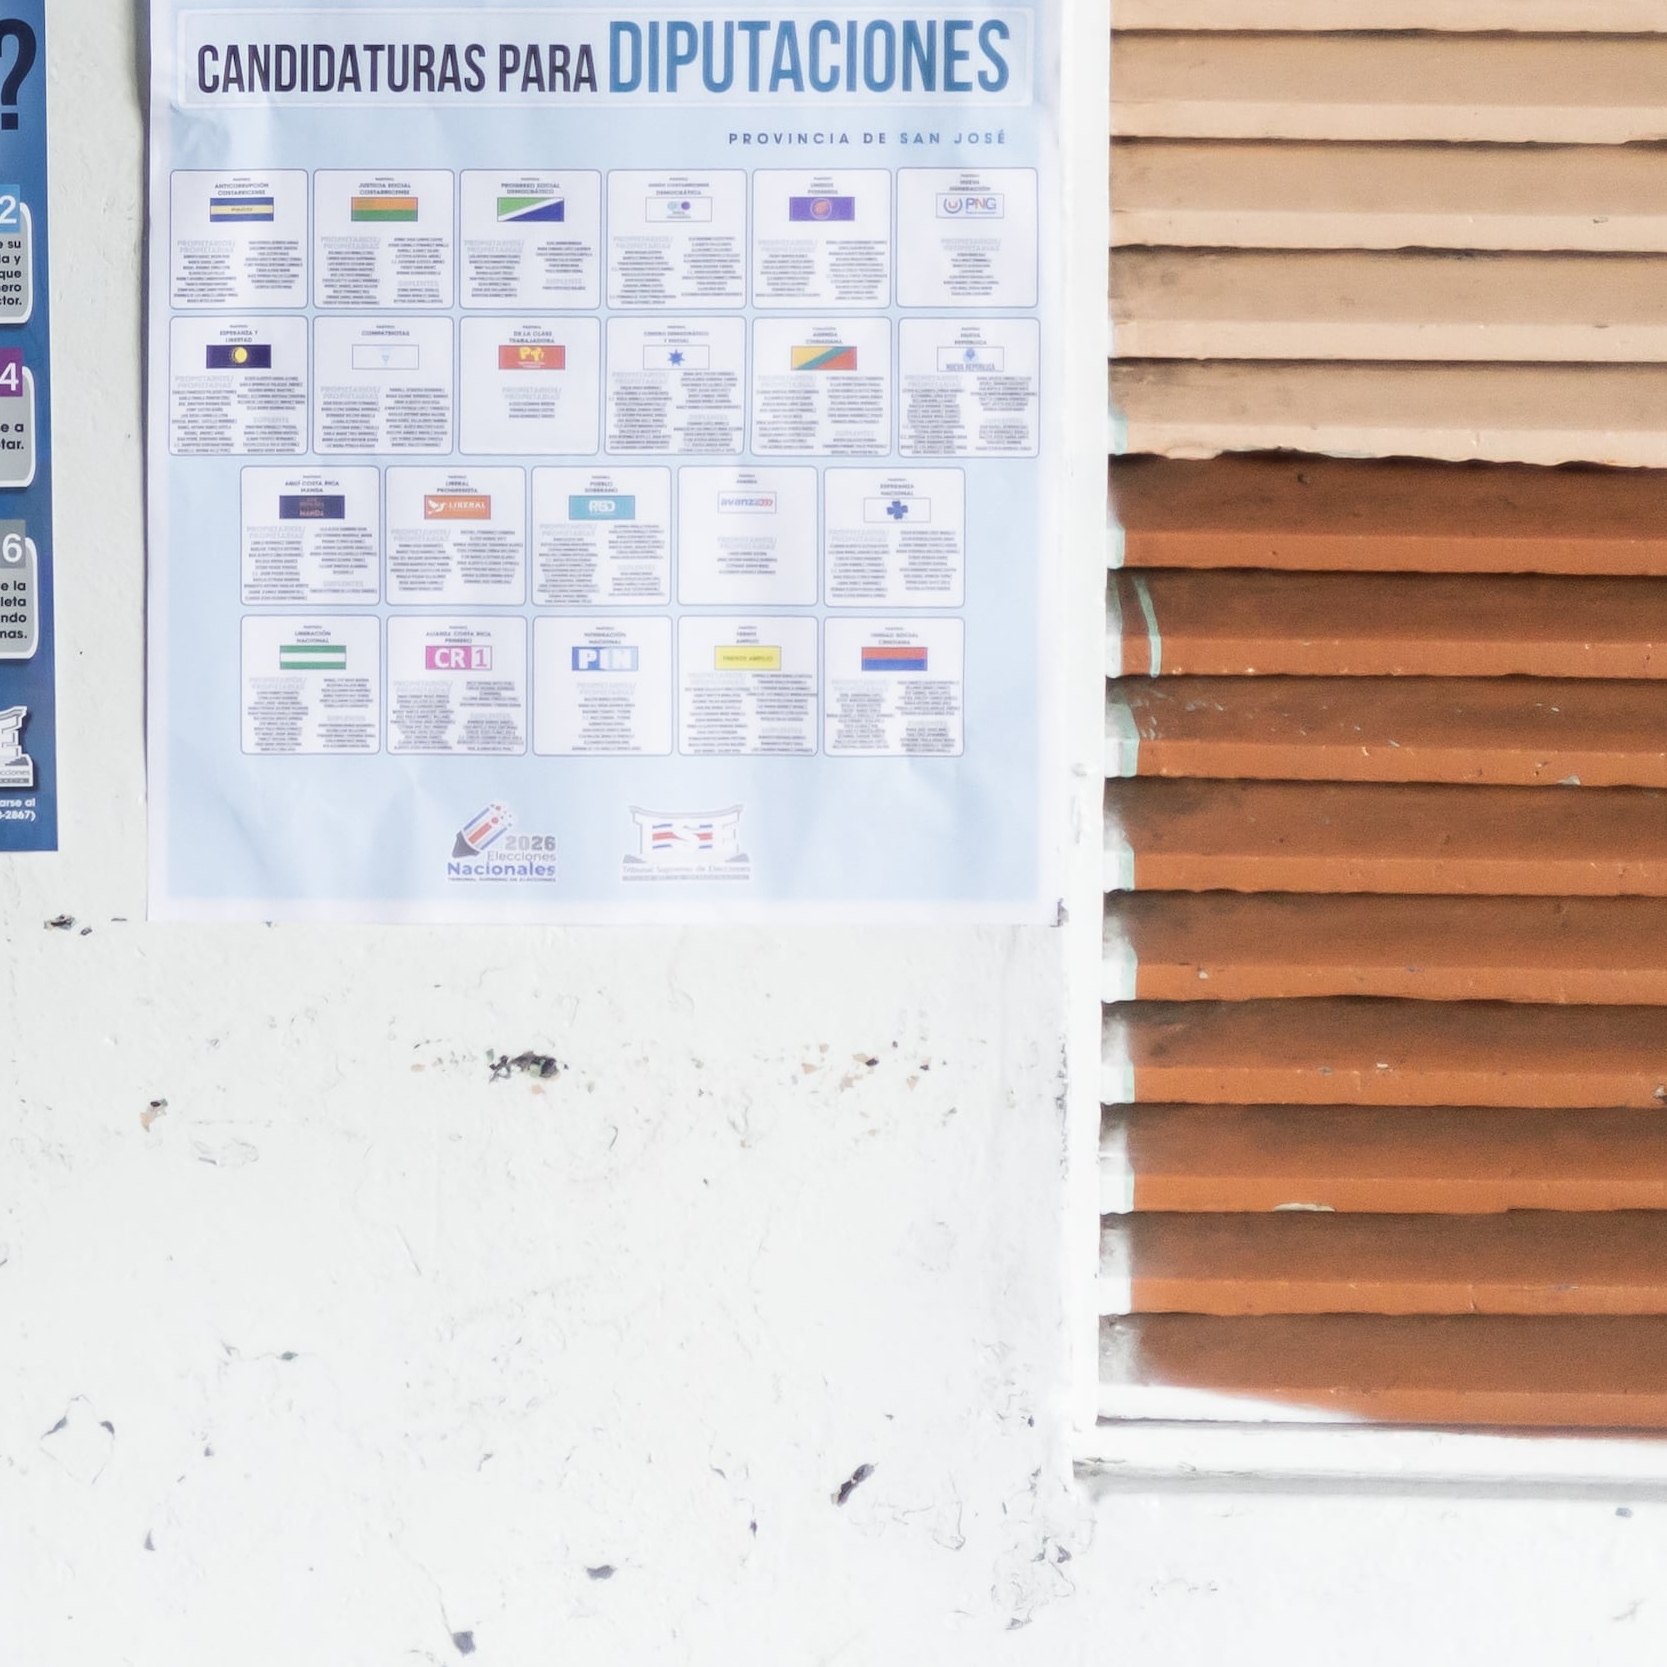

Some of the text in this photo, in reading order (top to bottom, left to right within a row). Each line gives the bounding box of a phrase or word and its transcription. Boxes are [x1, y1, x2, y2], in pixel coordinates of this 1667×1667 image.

[198, 20, 1009, 93] CANDIDATURAS PARA DIPUTACIONES
[729, 130, 1004, 144] PROVINCIA DE SAN JOSÉ
[965, 197, 997, 211] PNG
[14, 256, 20, 265] y
[15, 424, 24, 432] a
[448, 501, 486, 510] LIBERAL
[1, 533, 23, 562] 6
[14, 581, 26, 591] la
[434, 648, 465, 668] CR
[475, 649, 488, 668] 1
[25, 798, 35, 807] al
[505, 836, 555, 850] 2026
[487, 851, 556, 861] Elecciones
[448, 862, 555, 875] Nacionales
